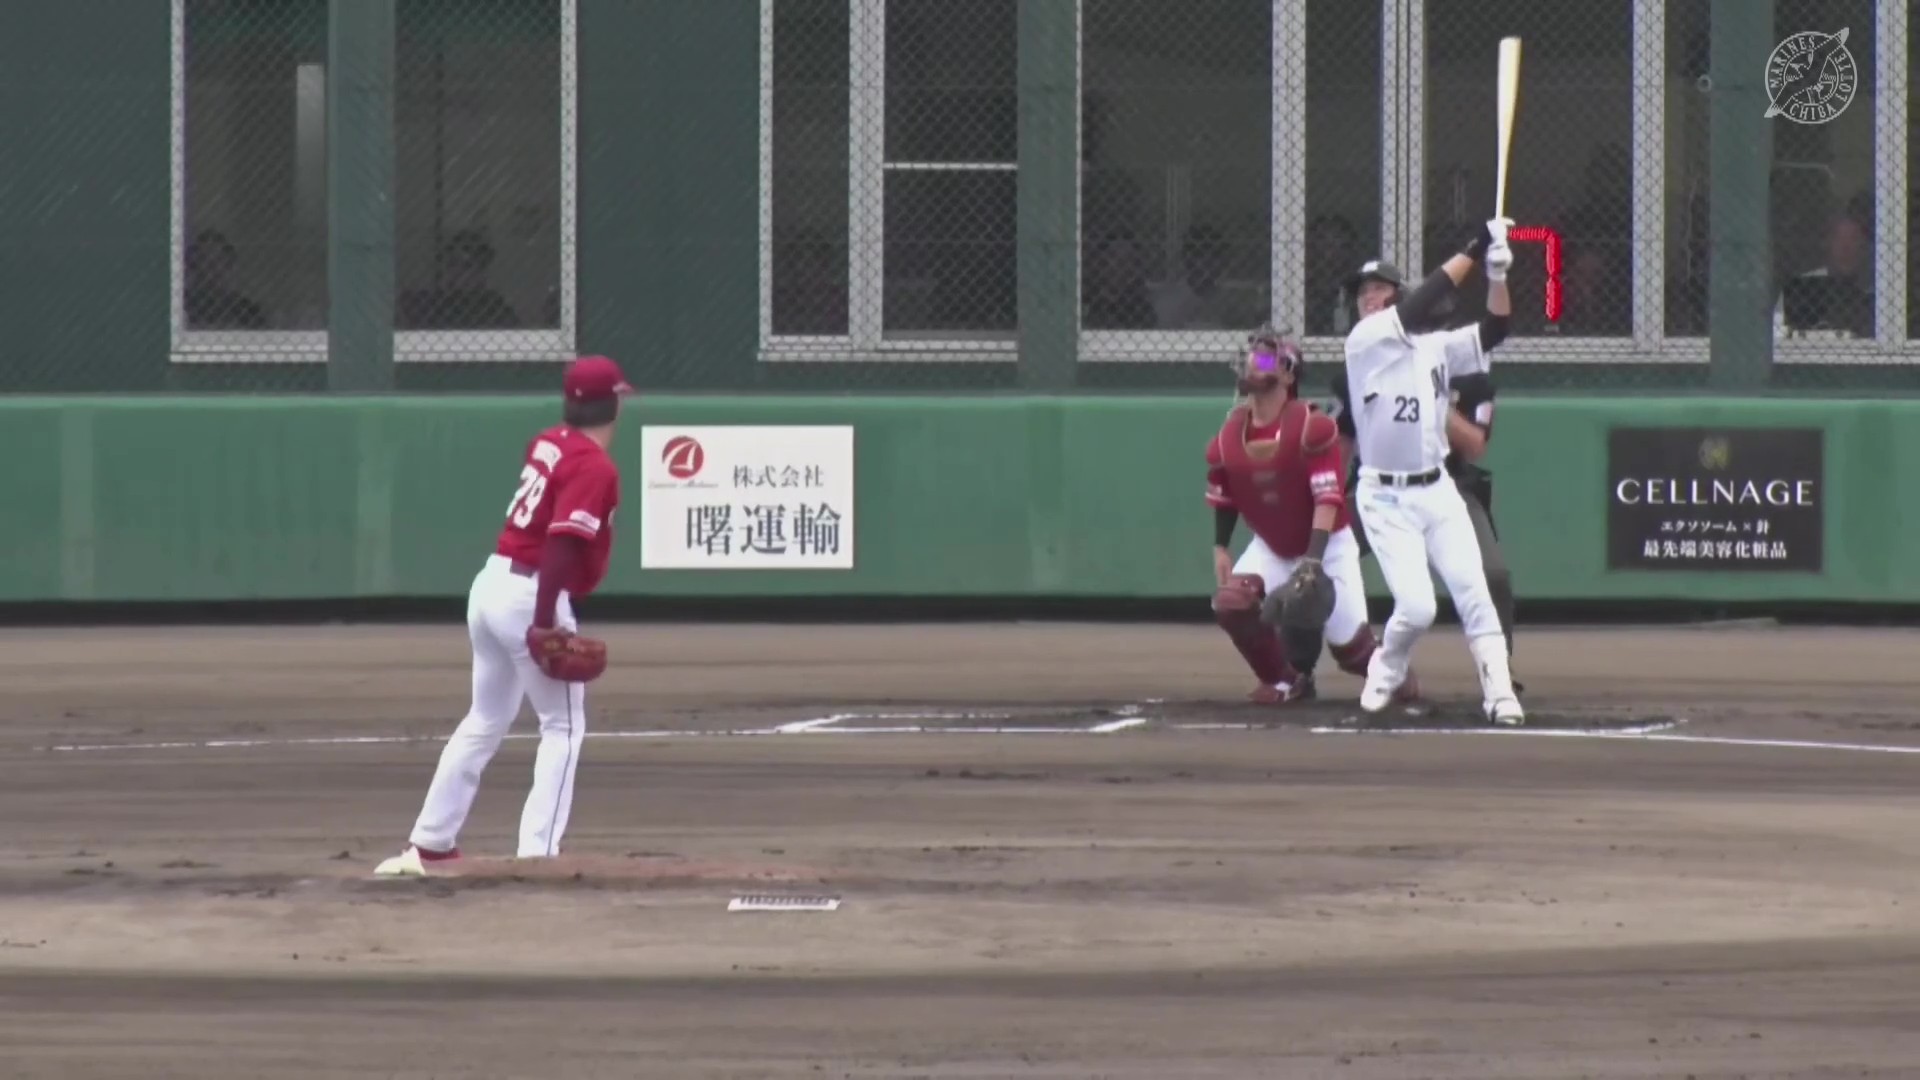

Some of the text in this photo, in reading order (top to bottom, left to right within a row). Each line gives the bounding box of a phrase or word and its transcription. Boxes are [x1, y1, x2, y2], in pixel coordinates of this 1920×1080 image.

[1393, 396, 1420, 423] 23
[733, 465, 824, 488] 株式会社
[506, 464, 547, 529] 79
[1616, 479, 1813, 505] CELLNAGE
[686, 502, 841, 556] 曙運輸
[1643, 540, 1787, 559] 最先端美容化粧品
